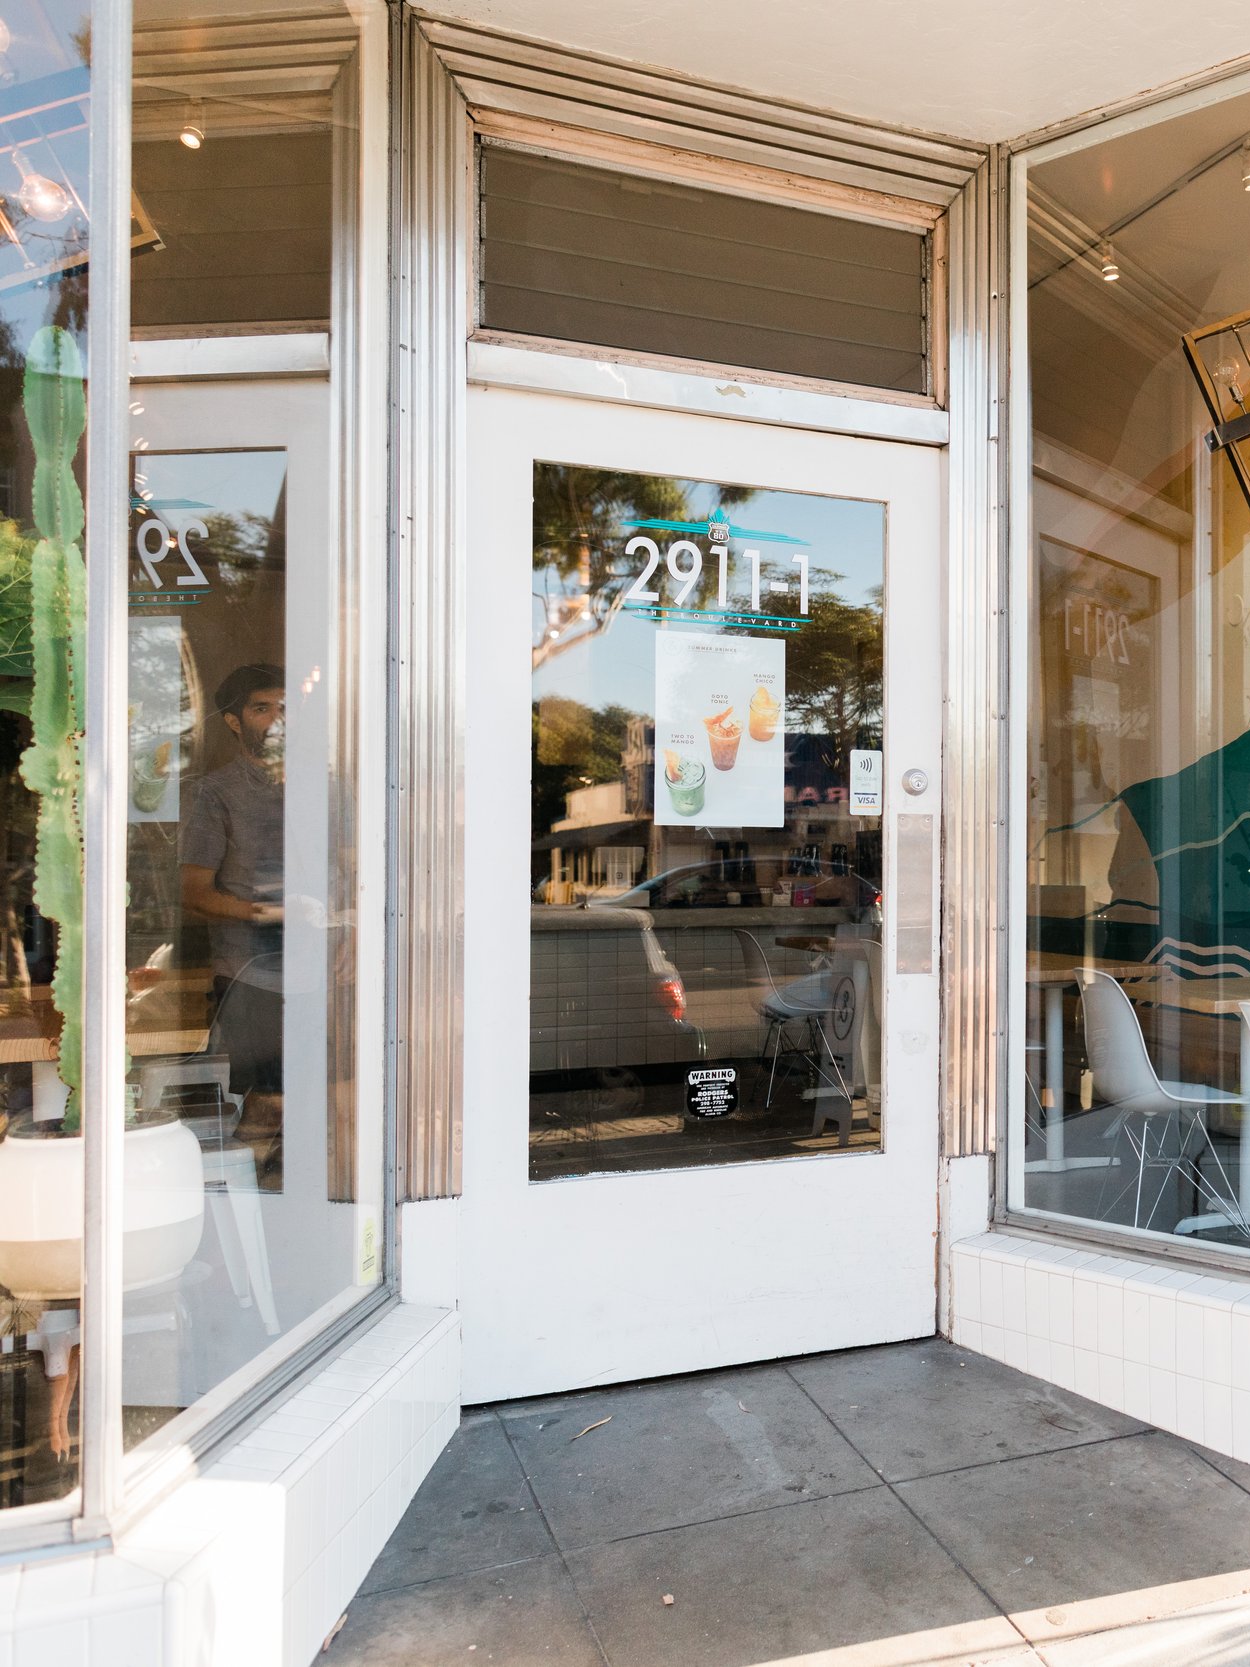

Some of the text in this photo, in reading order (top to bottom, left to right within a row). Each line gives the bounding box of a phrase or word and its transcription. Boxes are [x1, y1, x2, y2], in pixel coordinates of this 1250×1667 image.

[625, 536, 809, 615] 2911-1
[857, 796, 876, 804] VISA
[691, 1070, 733, 1080] WARNING
